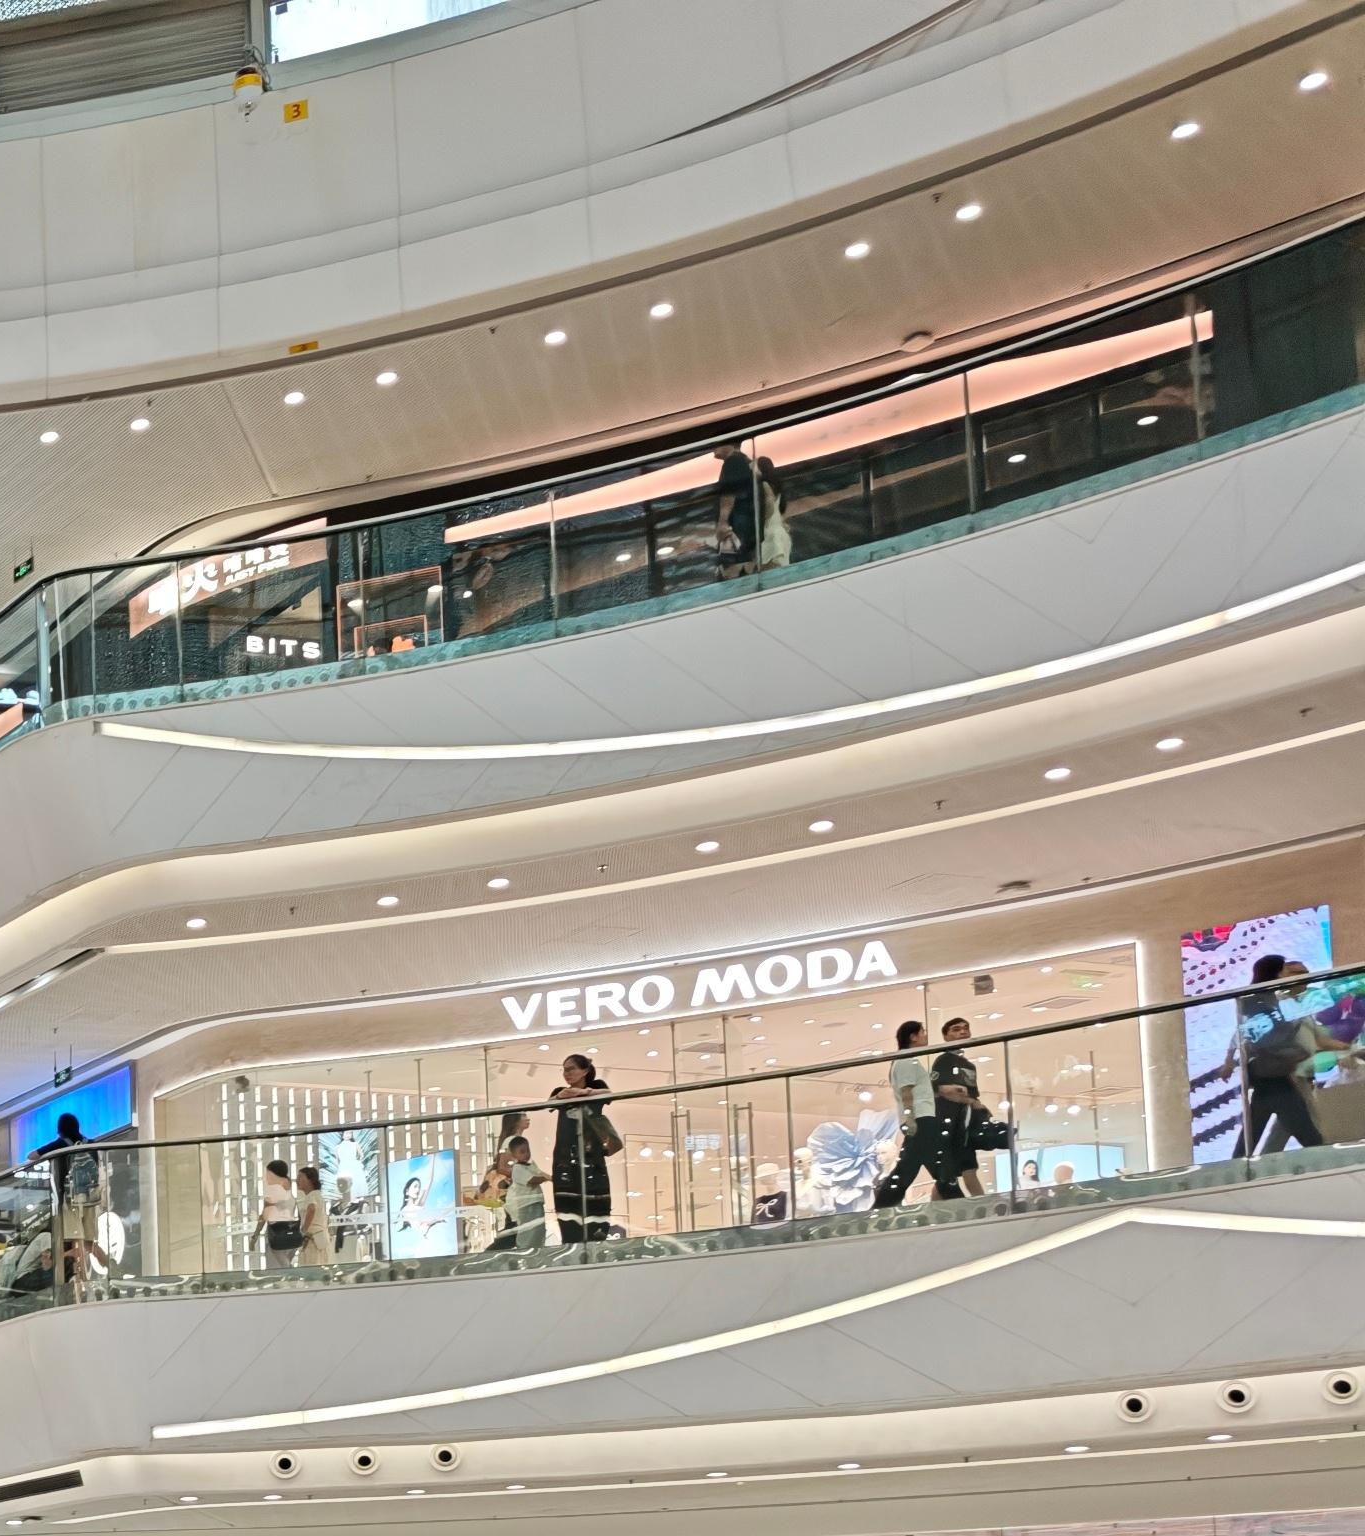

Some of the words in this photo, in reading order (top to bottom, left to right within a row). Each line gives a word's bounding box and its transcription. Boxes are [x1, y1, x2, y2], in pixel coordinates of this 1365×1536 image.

[246, 635, 321, 659] BITS
[502, 973, 675, 1031] VERO
[689, 940, 897, 1008] MODA
